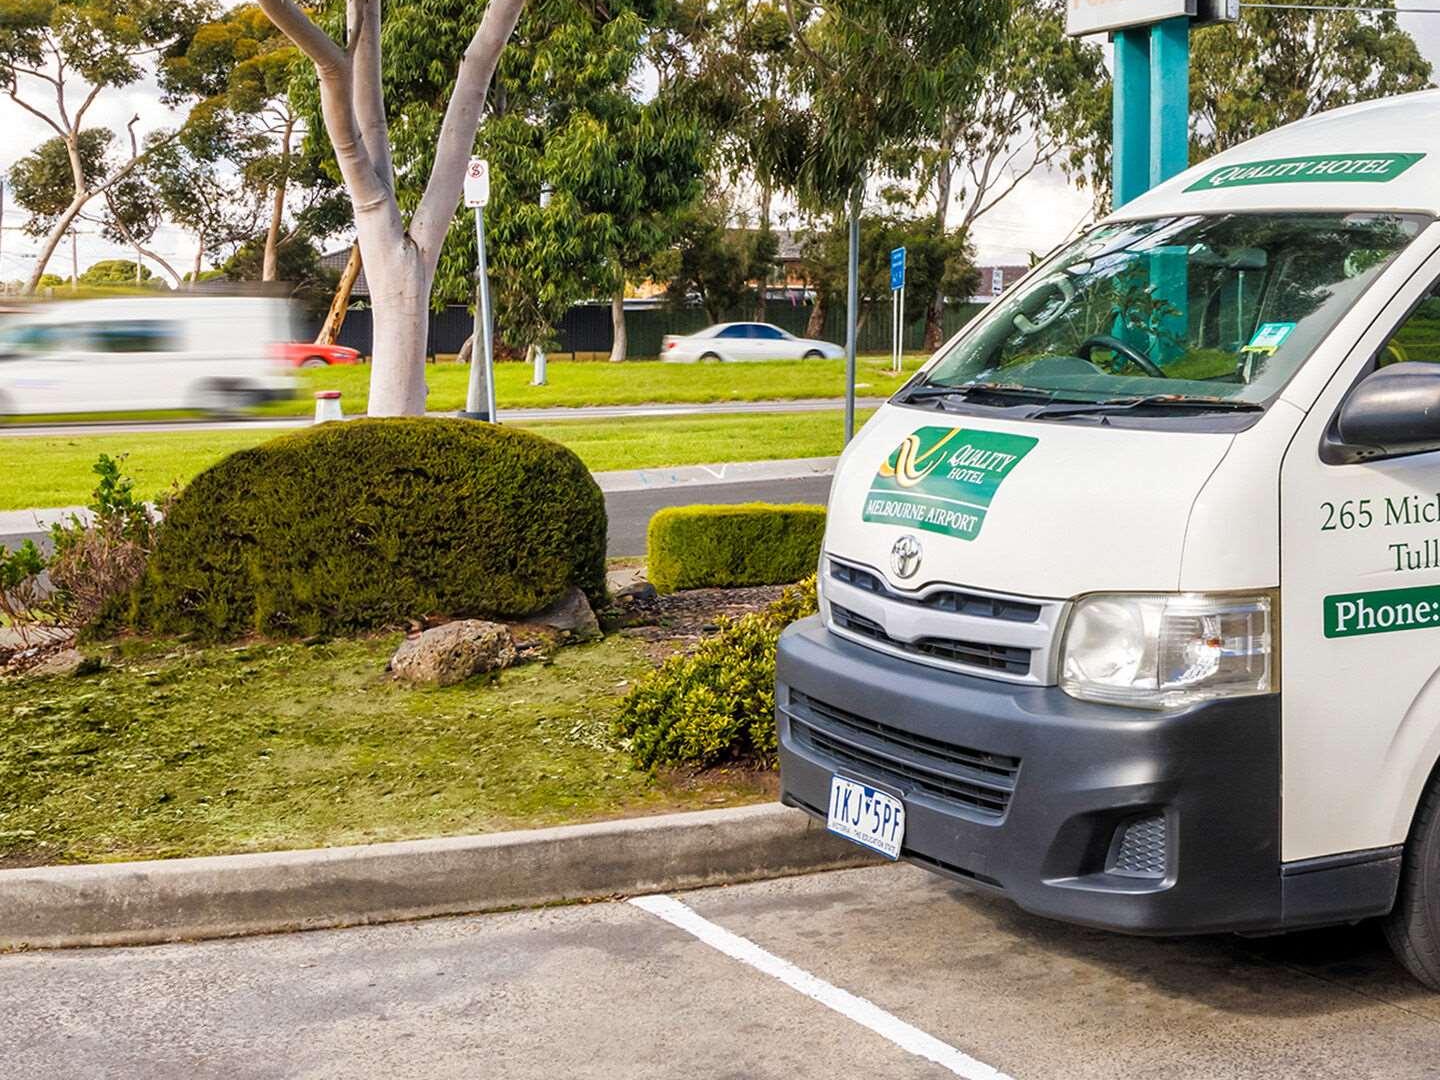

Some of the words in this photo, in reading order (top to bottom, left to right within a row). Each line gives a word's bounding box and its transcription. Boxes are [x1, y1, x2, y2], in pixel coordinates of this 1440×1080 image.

[1209, 162, 1311, 185] QUALITY
[1306, 159, 1395, 175] HOTEL
[947, 444, 1017, 472] QUALITY
[947, 467, 985, 484] HOTEL
[866, 500, 926, 521] MELBOURNE
[925, 508, 978, 532] AIRPORT
[1320, 499, 1372, 531] 265
[1335, 598, 1440, 632] Phone:
